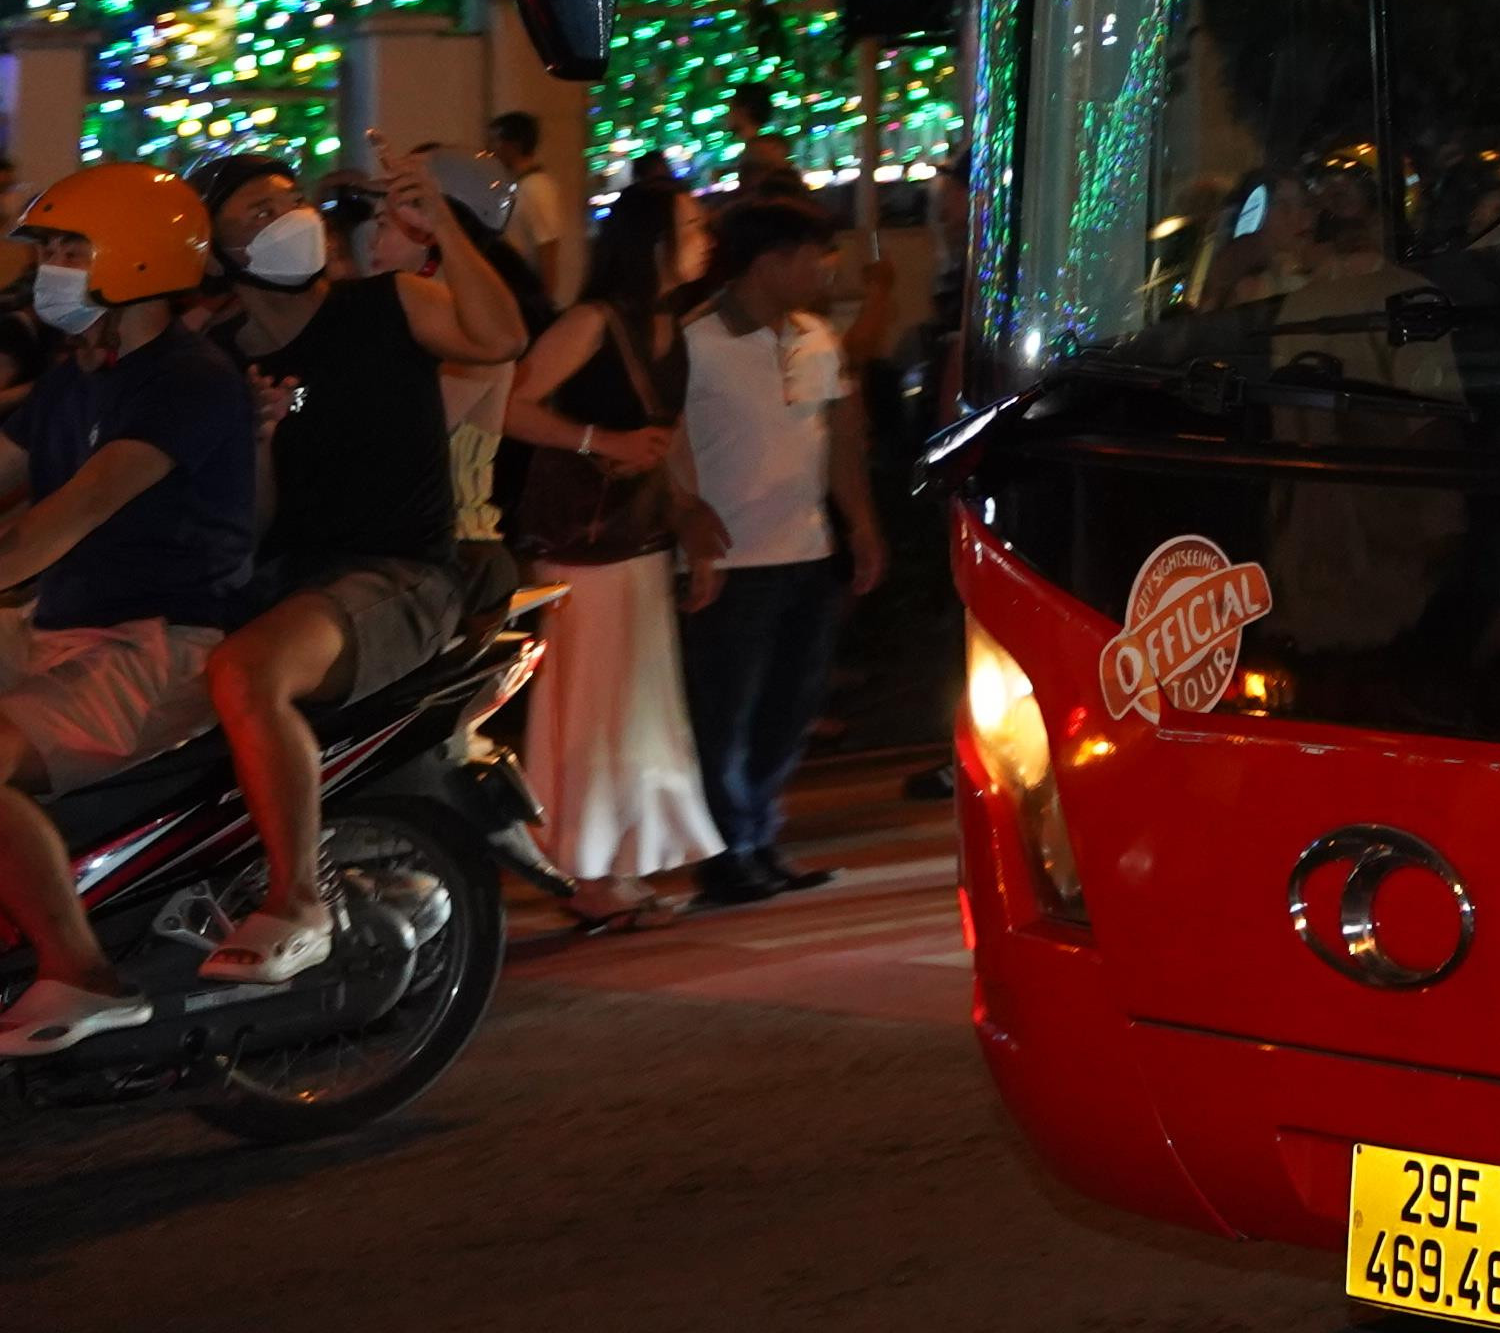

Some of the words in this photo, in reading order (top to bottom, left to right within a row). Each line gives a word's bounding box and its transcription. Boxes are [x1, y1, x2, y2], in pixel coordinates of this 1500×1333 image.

[1136, 583, 1154, 620] CITY
[1152, 549, 1219, 588] SIGHTSEEING
[1116, 573, 1262, 695] OFFICIAL
[1171, 647, 1232, 708] TOUR
[1401, 1159, 1480, 1233] 29E
